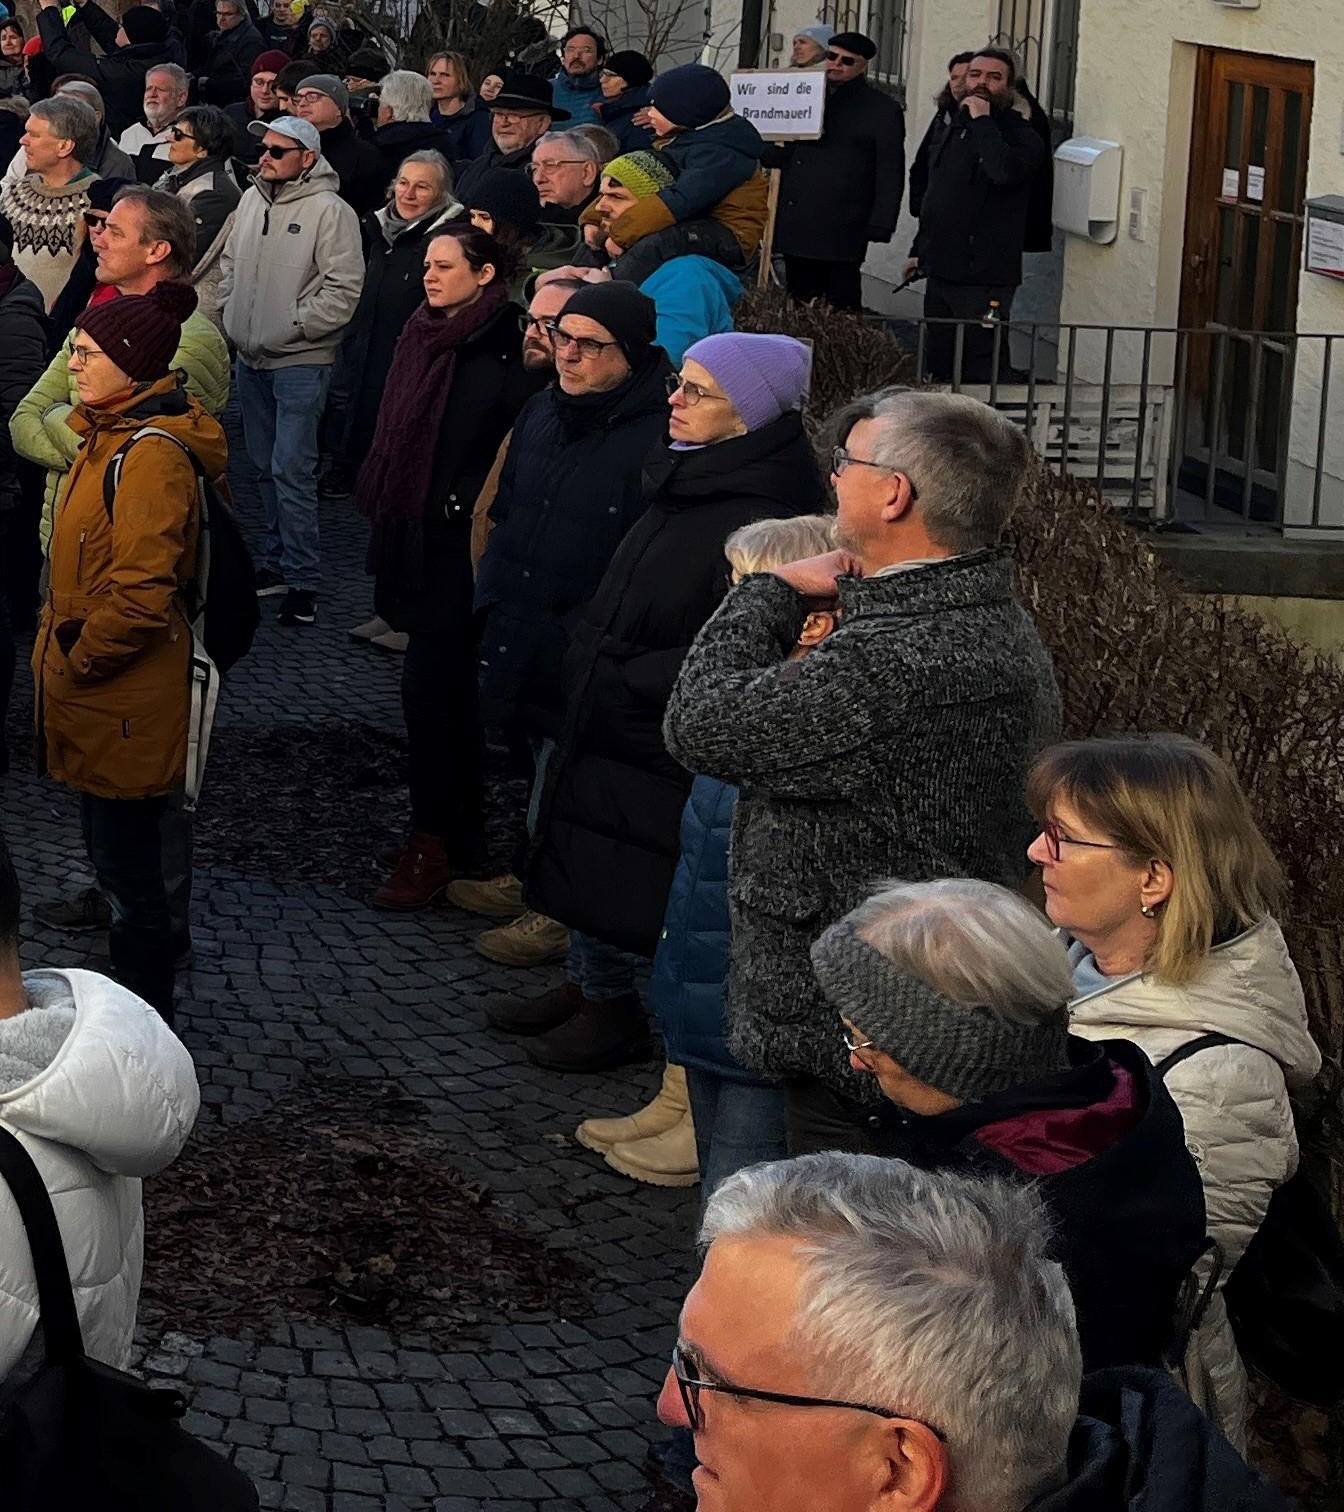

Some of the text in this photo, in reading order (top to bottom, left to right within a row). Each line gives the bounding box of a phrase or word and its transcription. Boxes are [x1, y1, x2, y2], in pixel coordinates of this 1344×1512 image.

[737, 82, 812, 95] Wir sind die
[743, 106, 812, 120] Brandmauer!
